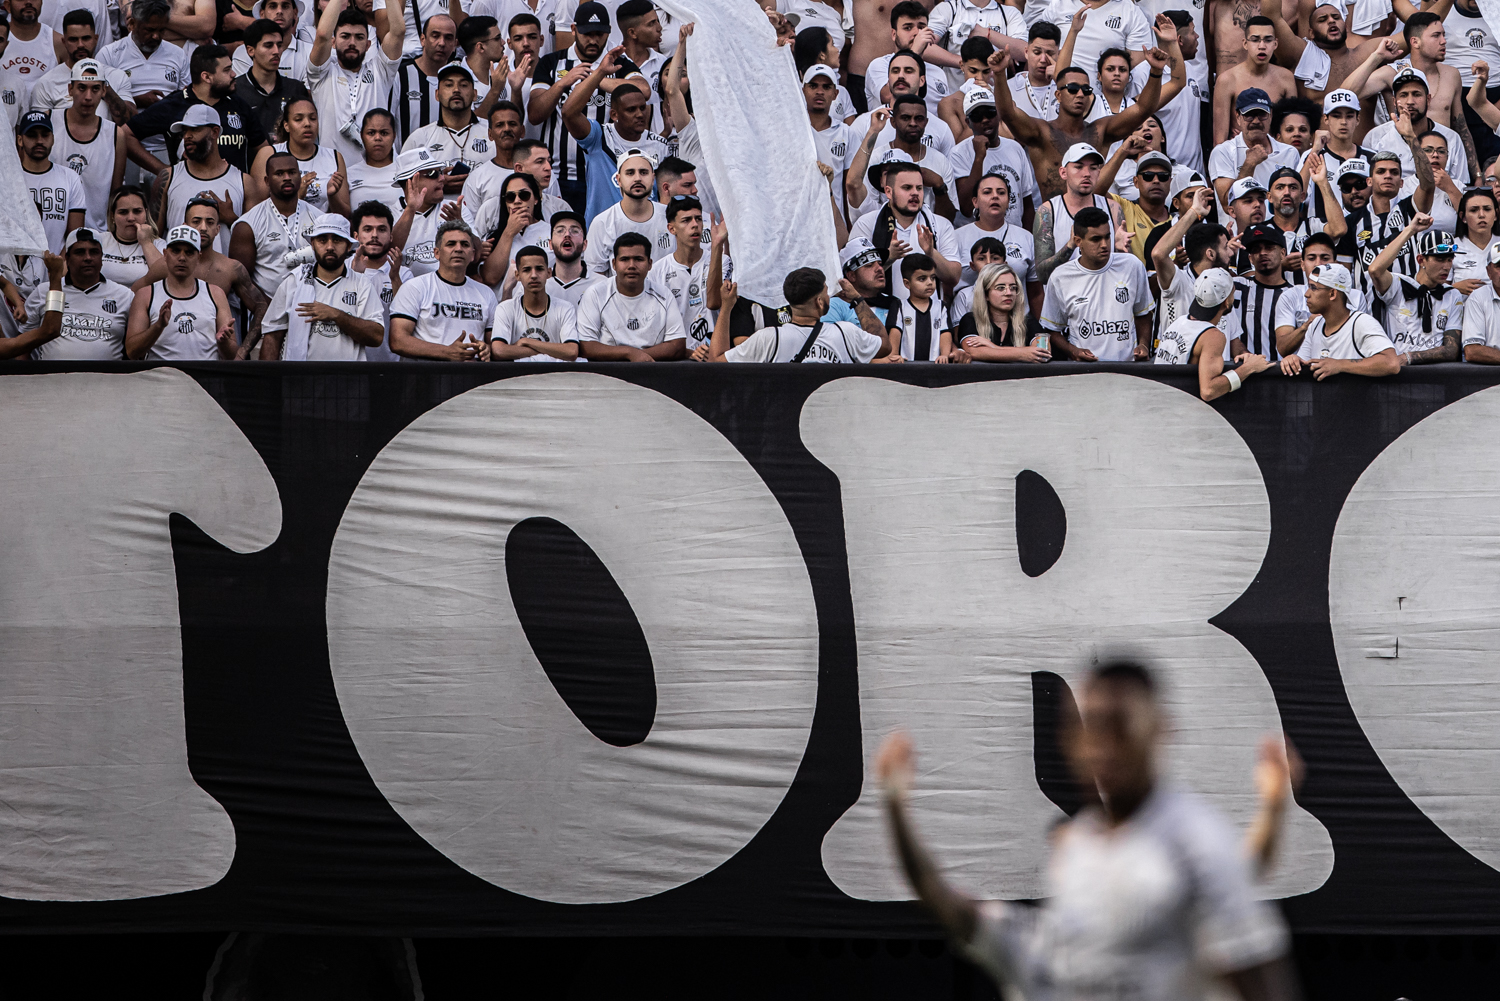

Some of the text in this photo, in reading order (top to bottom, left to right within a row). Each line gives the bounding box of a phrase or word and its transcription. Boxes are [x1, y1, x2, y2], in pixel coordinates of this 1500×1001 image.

[2, 57, 48, 72] LACOSTE
[1331, 92, 1351, 103] SFC
[217, 134, 244, 150] mup
[1339, 162, 1366, 175] JOVEM
[45, 213, 66, 221] JOVEM
[170, 227, 198, 242] SFC
[456, 300, 482, 309] TORCIDA
[431, 302, 484, 322] JOVEM
[62, 314, 112, 328] Charlie
[1092, 319, 1130, 335] blaze
[61, 326, 98, 339] Brown
